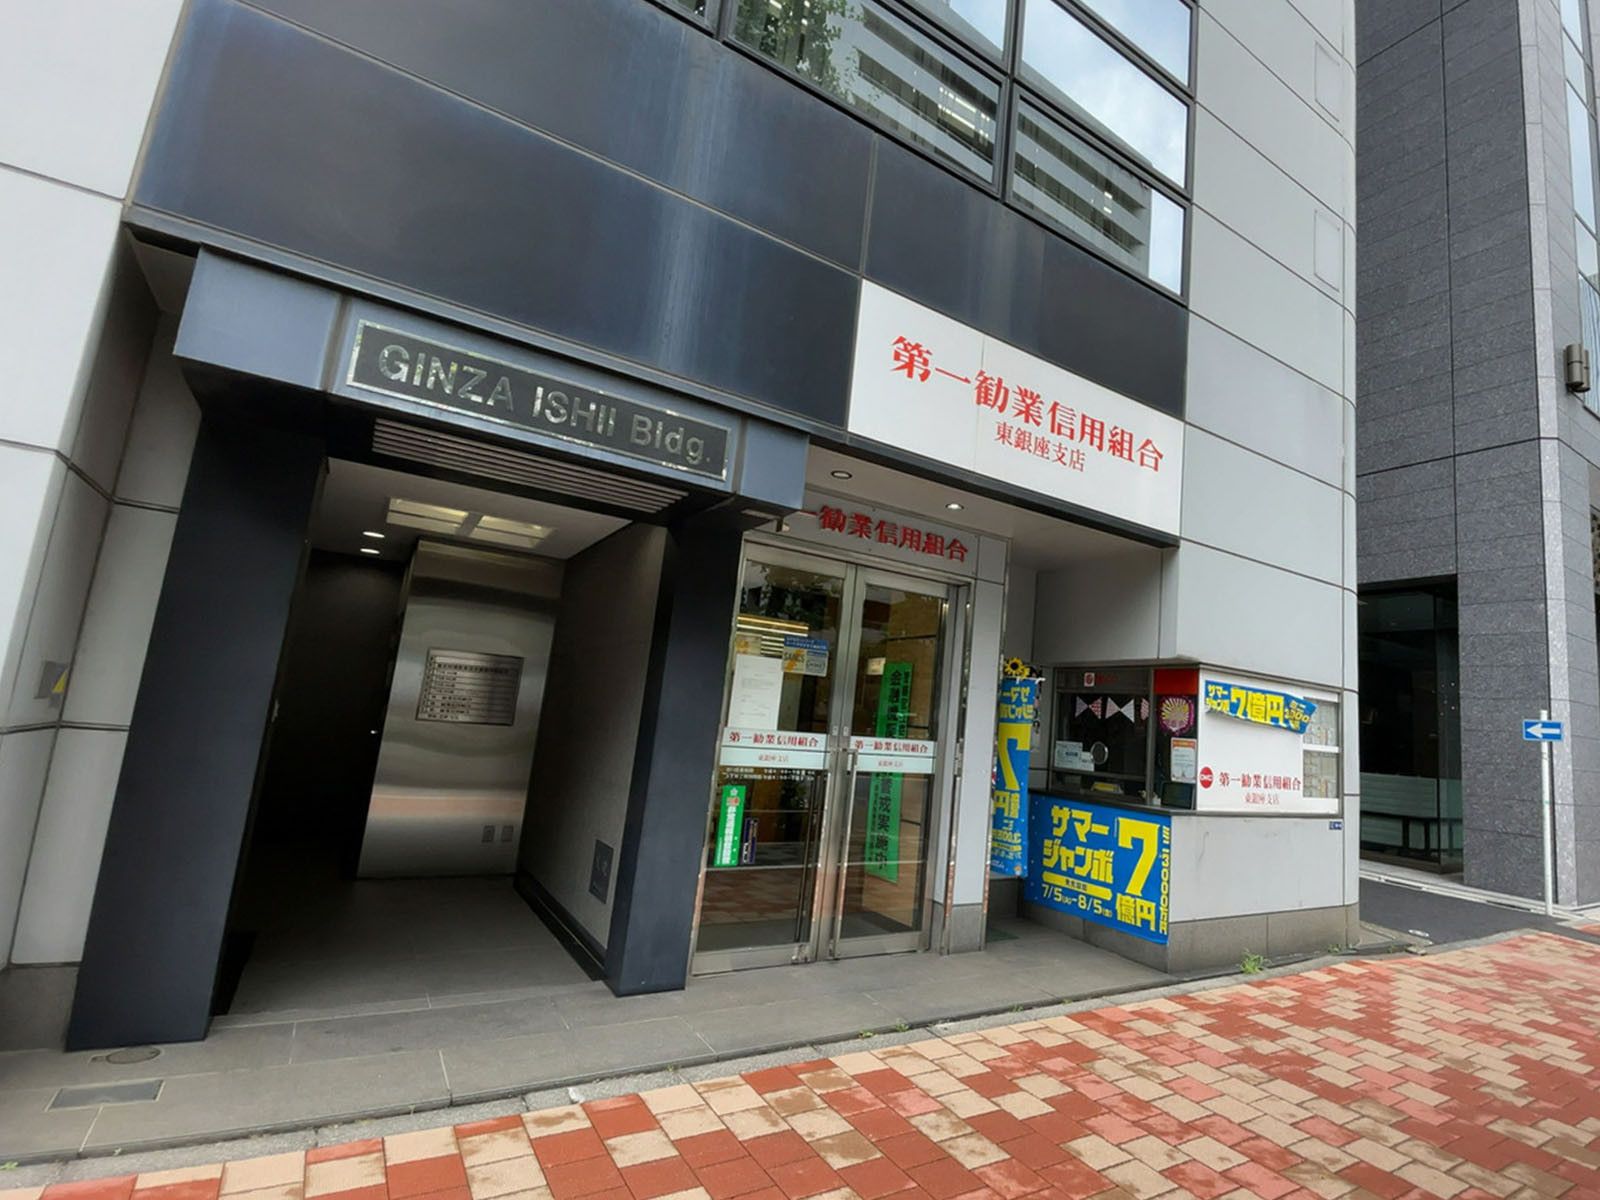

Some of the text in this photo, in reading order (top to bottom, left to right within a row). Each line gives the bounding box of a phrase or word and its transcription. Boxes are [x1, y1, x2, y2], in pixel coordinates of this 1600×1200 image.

[378, 344, 711, 465] GINZA ISHII Bldg.
[891, 336, 1164, 472] 第一勧業信用組合
[994, 421, 1085, 472] 東銀座支店
[1230, 687, 1284, 726] 7億円
[1219, 772, 1302, 791] 第一勧業信用組合
[1051, 805, 1110, 843] サマー
[1042, 838, 1114, 884] ジャンボ
[1117, 816, 1160, 897] 7
[1115, 893, 1156, 932] 億円
